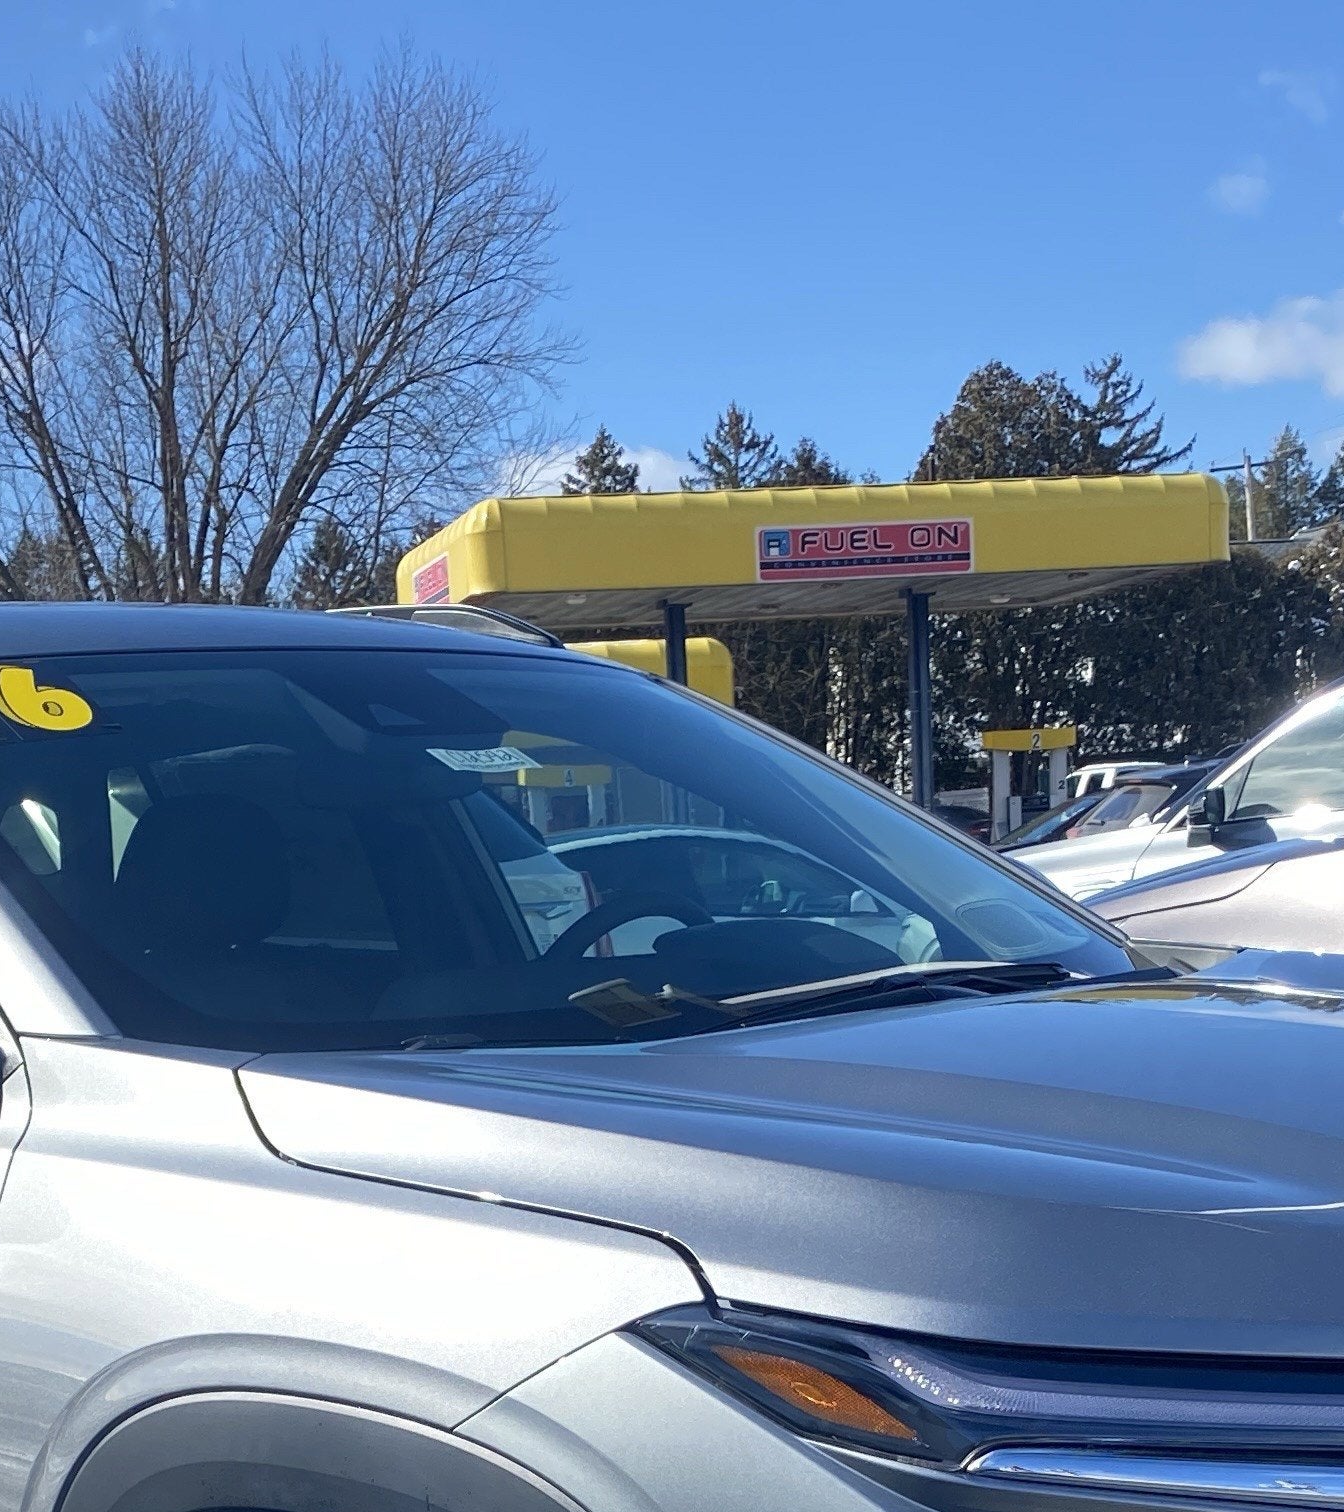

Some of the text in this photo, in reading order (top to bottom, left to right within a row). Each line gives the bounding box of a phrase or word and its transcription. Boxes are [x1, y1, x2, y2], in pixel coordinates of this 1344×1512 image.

[799, 523, 961, 554] FUEL ON
[1032, 733, 1041, 749] 2
[1058, 779, 1066, 790] 2
